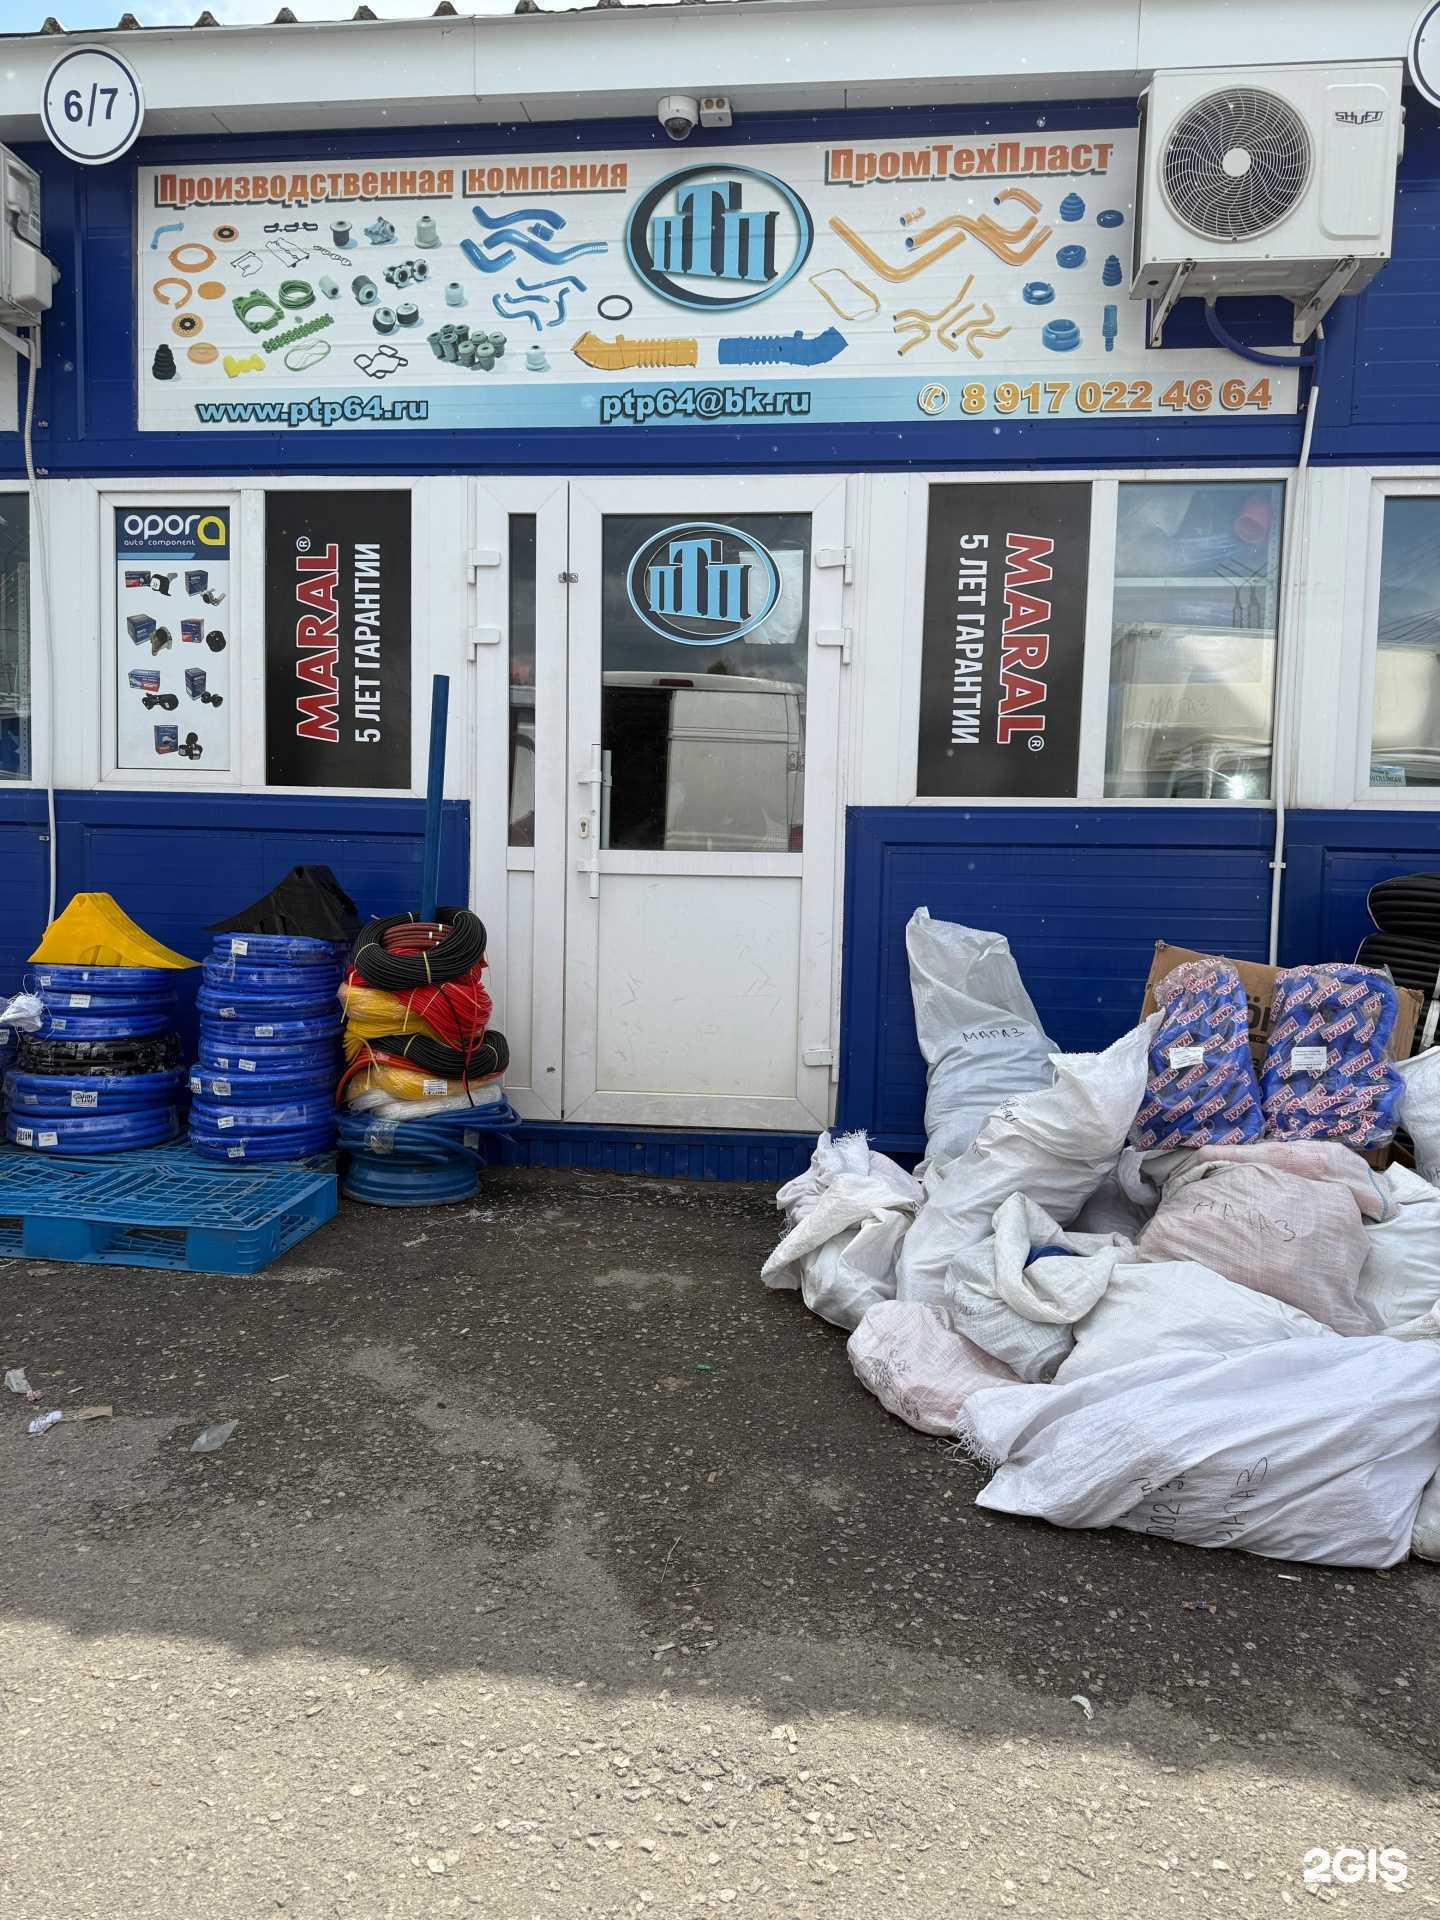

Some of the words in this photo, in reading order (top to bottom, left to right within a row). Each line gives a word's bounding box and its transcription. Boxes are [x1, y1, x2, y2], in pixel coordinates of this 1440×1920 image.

[64, 83, 119, 127] 6/7
[825, 142, 1114, 188] ПромТехПласт
[155, 171, 455, 211] Производственная
[463, 163, 629, 199] компания
[196, 395, 430, 427] www.ptp64.ru
[600, 387, 812, 424] ptp64@bk.ru
[961, 382, 987, 414] 8
[995, 381, 1072, 413] 917
[1077, 379, 1154, 412] 022
[1160, 378, 1214, 411] 46
[1220, 377, 1274, 410] 64
[124, 514, 226, 546] opora
[147, 539, 196, 547] component
[959, 534, 990, 550] 5
[957, 557, 988, 606] ЛЕТ
[354, 543, 382, 669] ГАРАНТИИ
[951, 613, 986, 744] ГАРАНТИИ
[354, 674, 382, 722] ЛЕТ
[354, 728, 382, 743] 5
[1312, 980, 1341, 1008] MARAL
[1179, 1002, 1207, 1024] MARAL
[1323, 1014, 1356, 1042] MARAL
[1341, 1052, 1373, 1076] MARAL
[1369, 1064, 1388, 1079] RAL
[1195, 1096, 1224, 1120] MARAL
